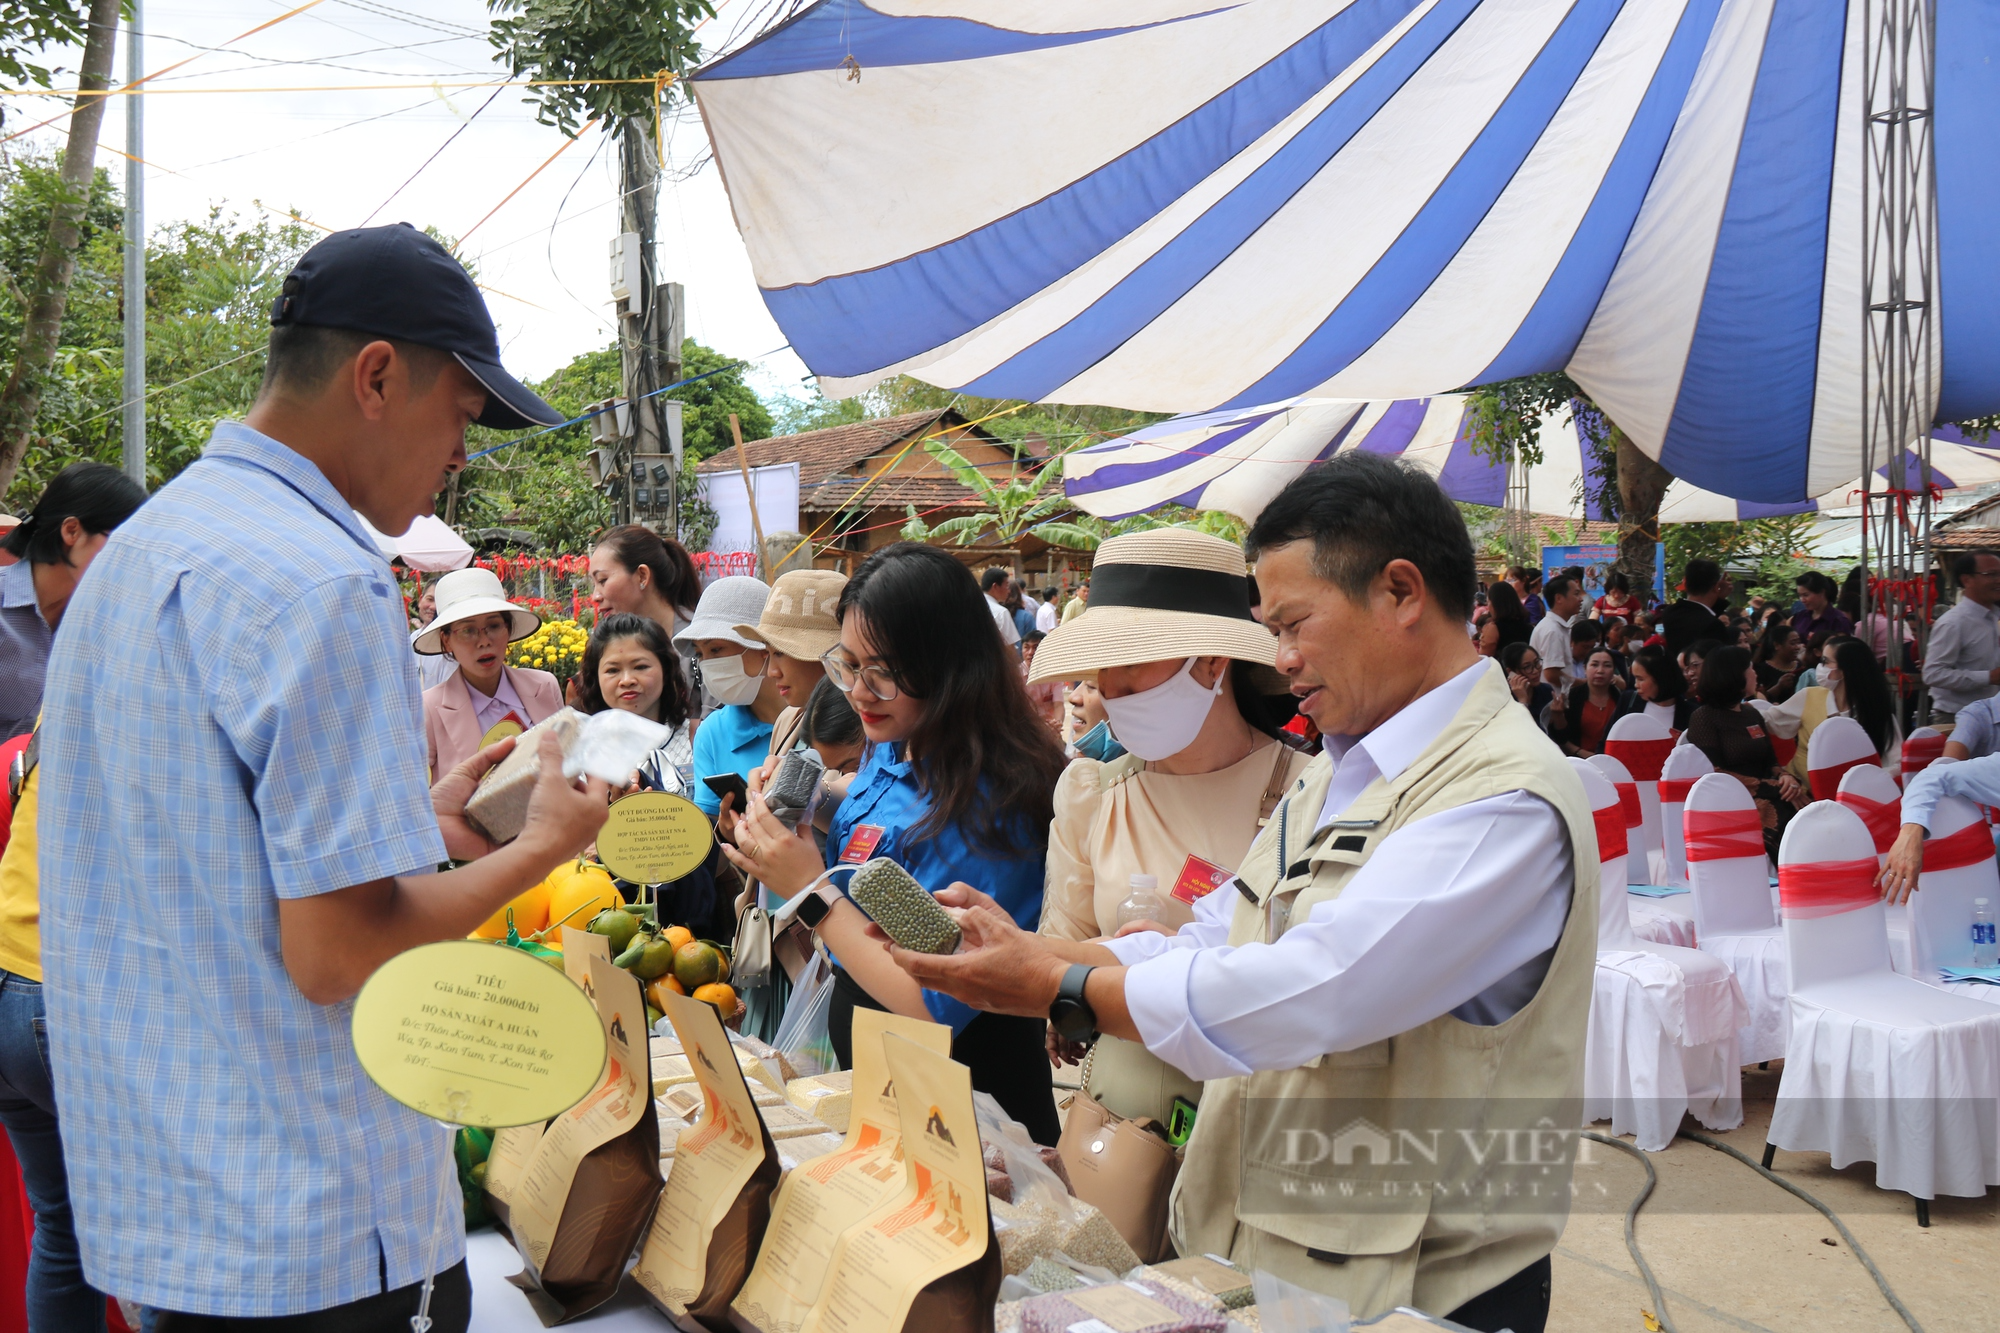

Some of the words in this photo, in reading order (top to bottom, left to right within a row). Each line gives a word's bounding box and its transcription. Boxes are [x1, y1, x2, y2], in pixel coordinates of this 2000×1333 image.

[434, 981, 454, 993] Giá
[456, 985, 481, 1000] bán:
[477, 974, 506, 989] TIÊU
[421, 1004, 438, 1016] HỘ
[440, 1008, 462, 1020] SẢN
[464, 1014, 496, 1028] XUẤT
[496, 1022, 504, 1030] A
[424, 1022, 449, 1036] Thôn
[500, 1042, 514, 1051] xã
[397, 1032, 414, 1046] Wa,
[418, 1037, 432, 1050] Tp.
[434, 1042, 458, 1054] Kon
[462, 1047, 485, 1062] Tum,
[489, 1053, 498, 1064] T.
[499, 1057, 524, 1069] Kon
[526, 1062, 549, 1076] Tum
[404, 1054, 431, 1068] SĐT:
